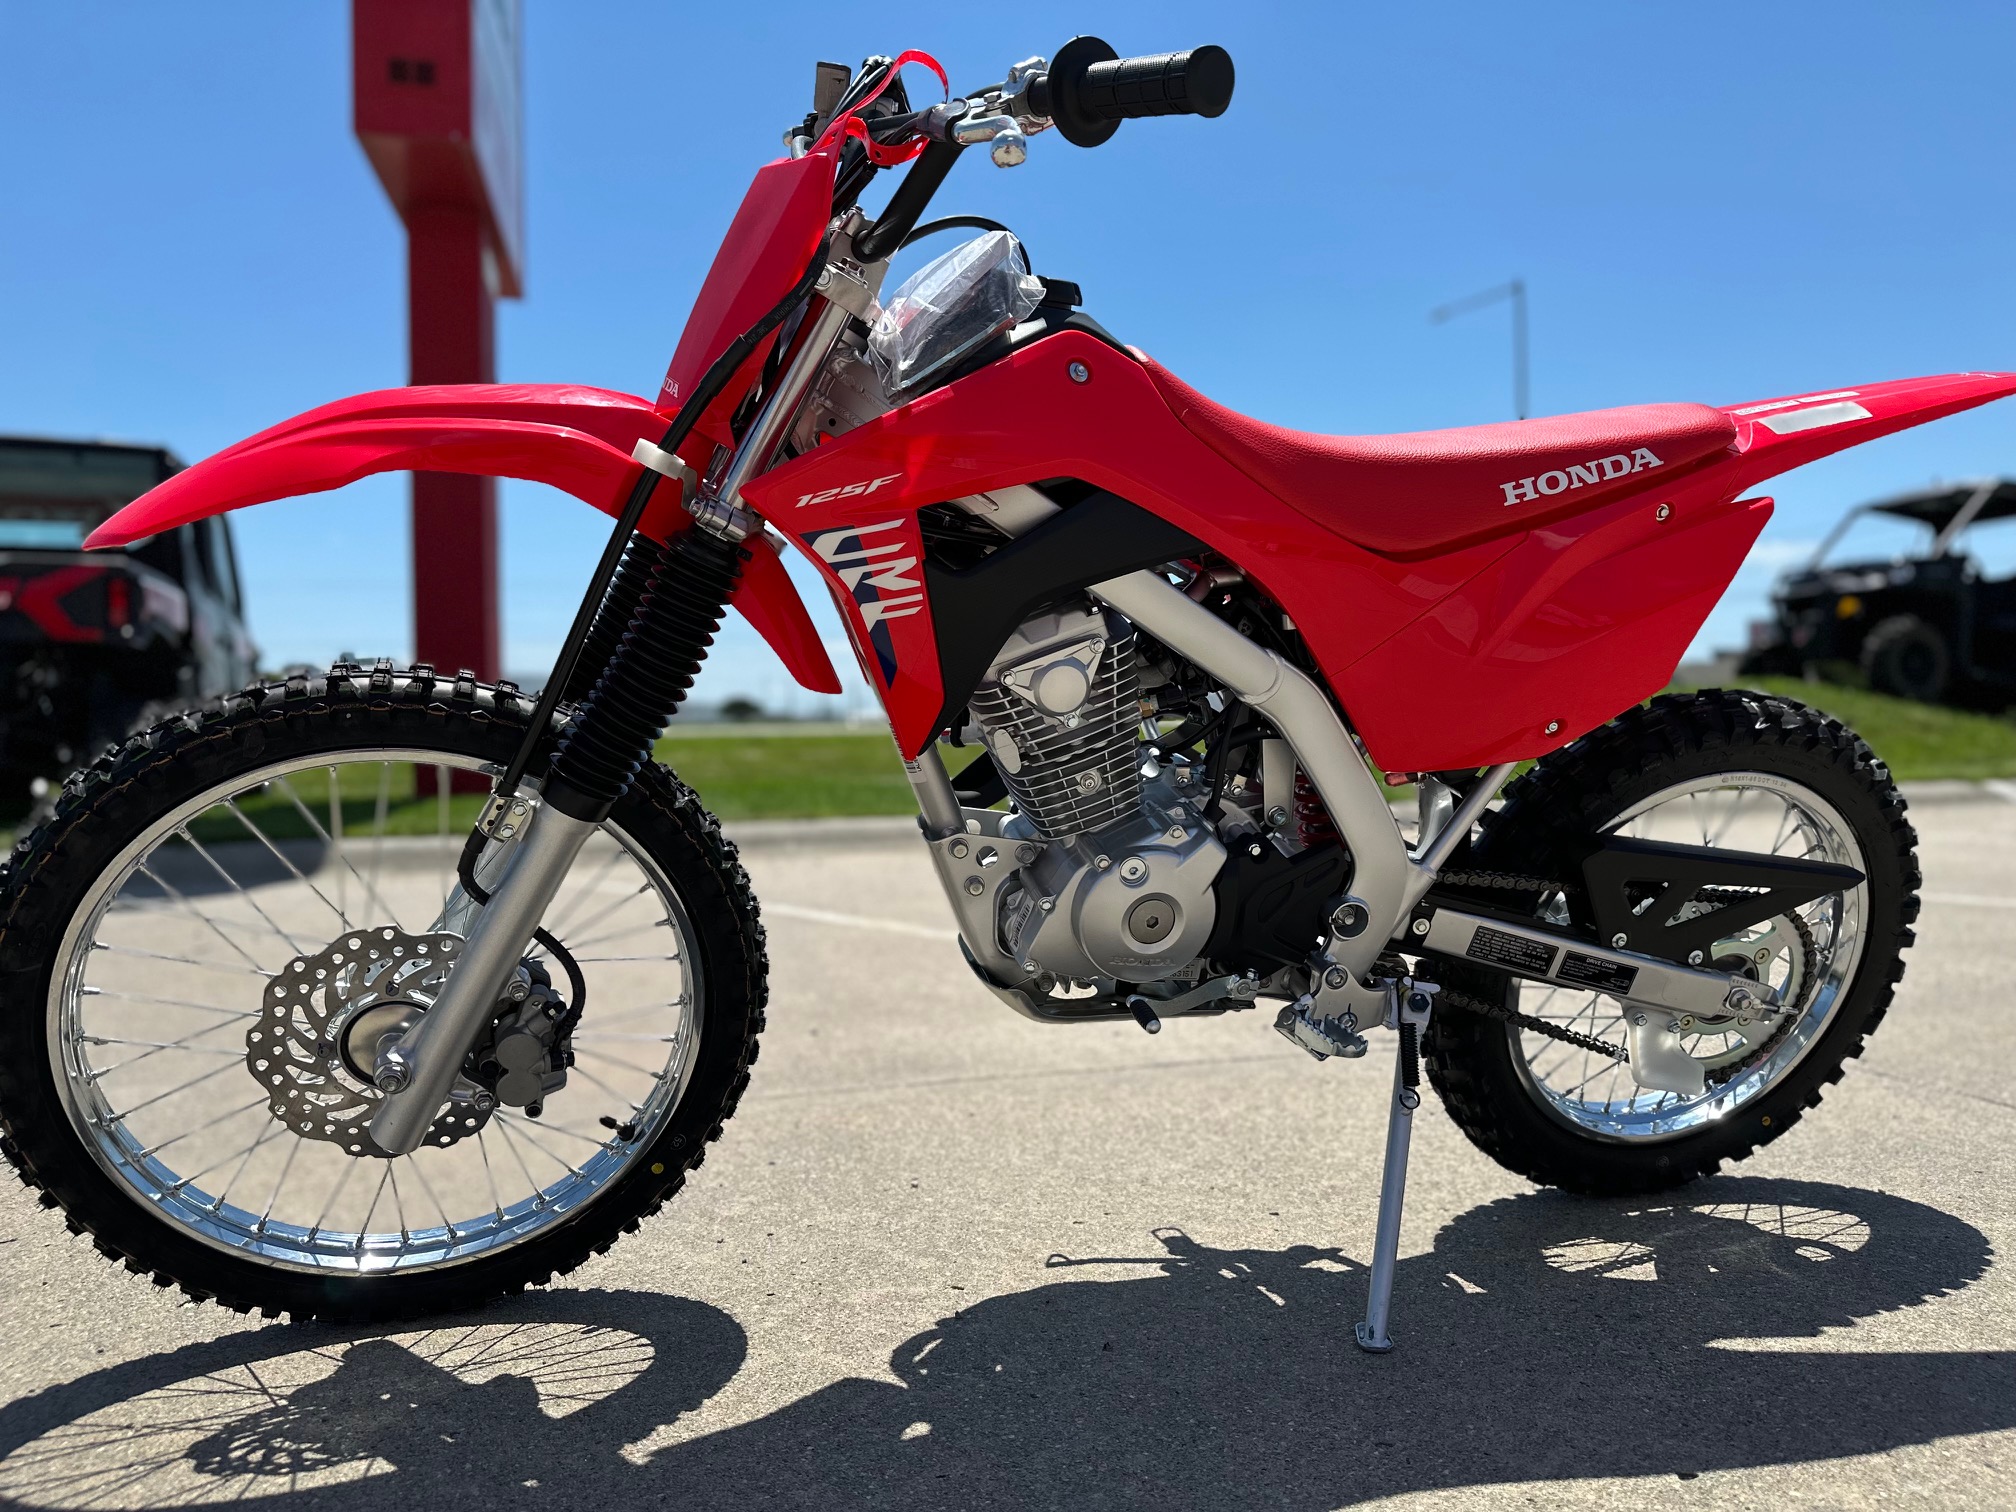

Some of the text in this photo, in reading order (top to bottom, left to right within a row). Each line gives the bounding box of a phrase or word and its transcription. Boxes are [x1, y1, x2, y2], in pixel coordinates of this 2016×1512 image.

[1500, 447, 1664, 507] HONDA
[795, 473, 904, 508] 125F
[1108, 956, 1176, 967] HONDA
[1586, 957, 1617, 970] DRIVE CHAIN
